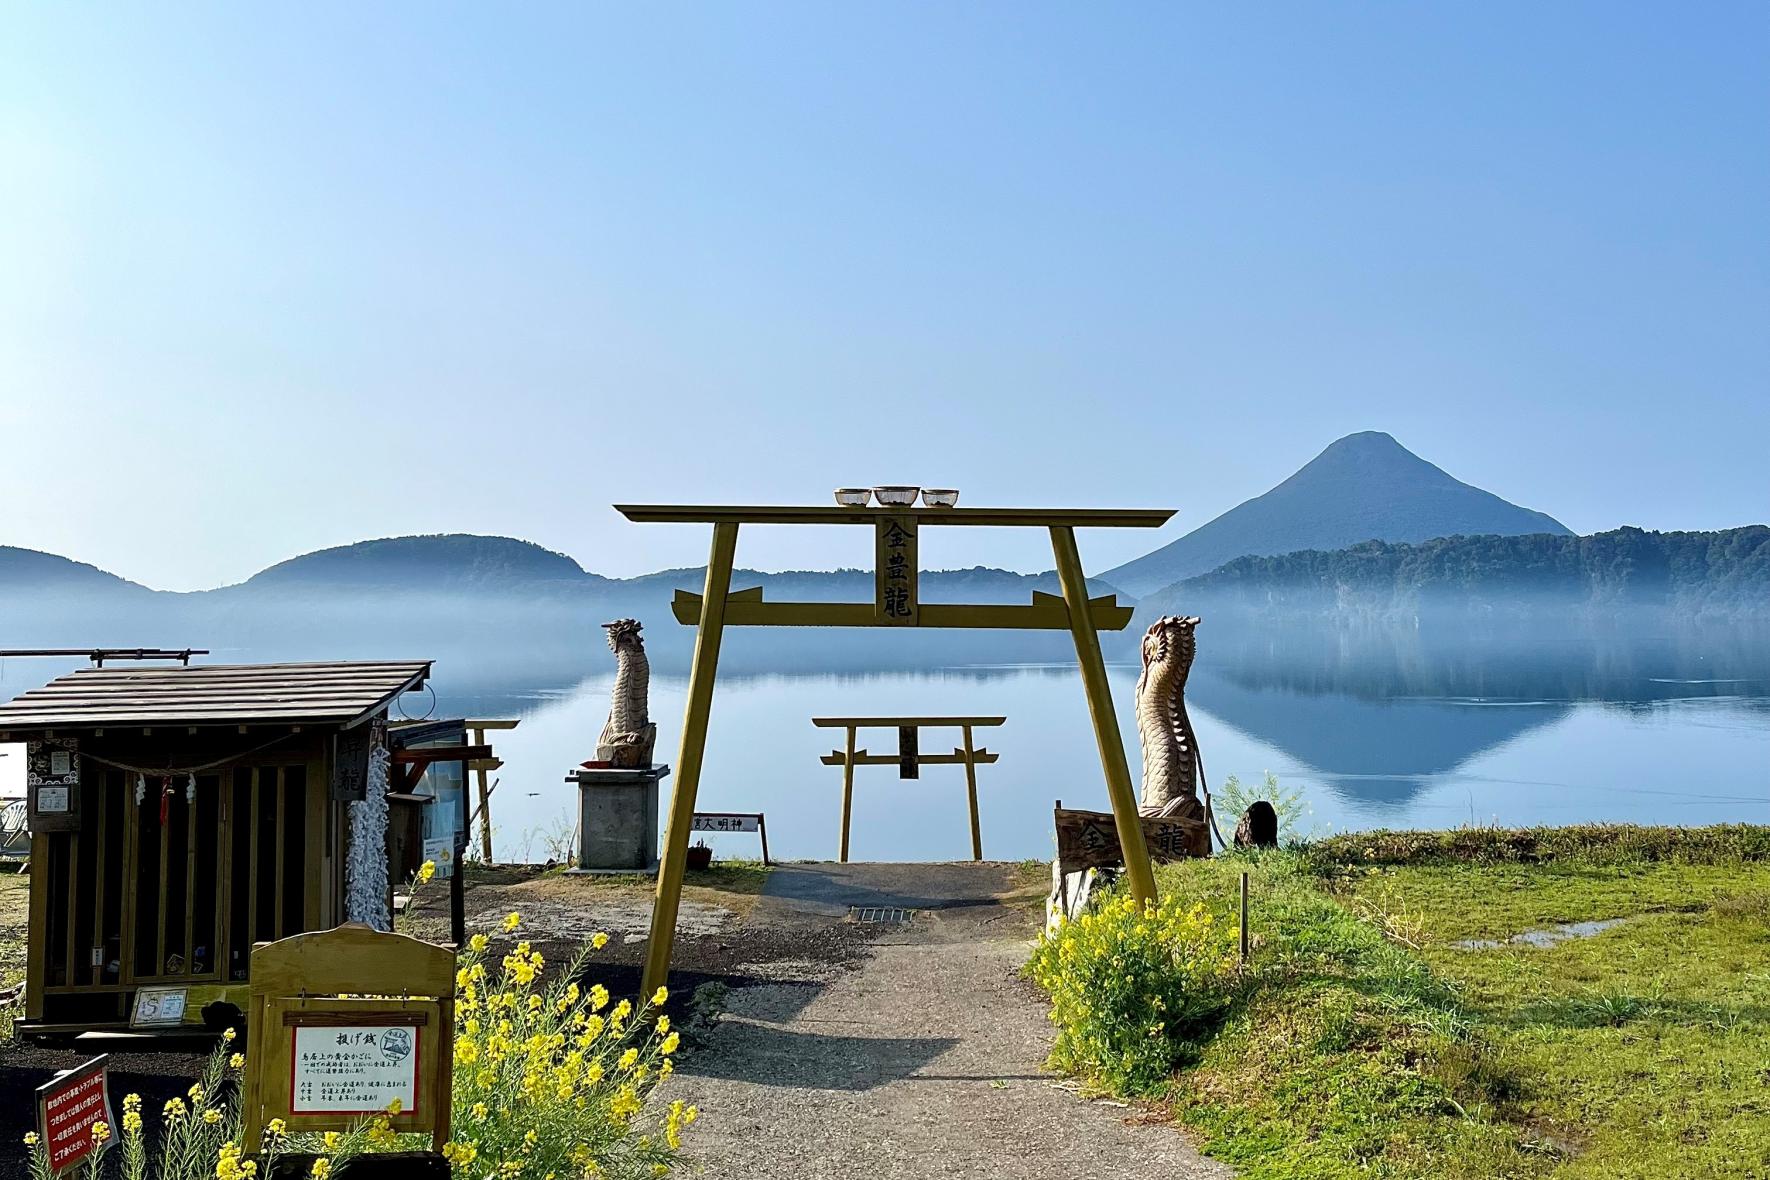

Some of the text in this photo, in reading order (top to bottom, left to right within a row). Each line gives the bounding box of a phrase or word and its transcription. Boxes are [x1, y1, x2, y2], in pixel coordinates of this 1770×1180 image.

[882, 521, 915, 618] 金豊龍
[336, 1032, 377, 1046] 投げ銭
